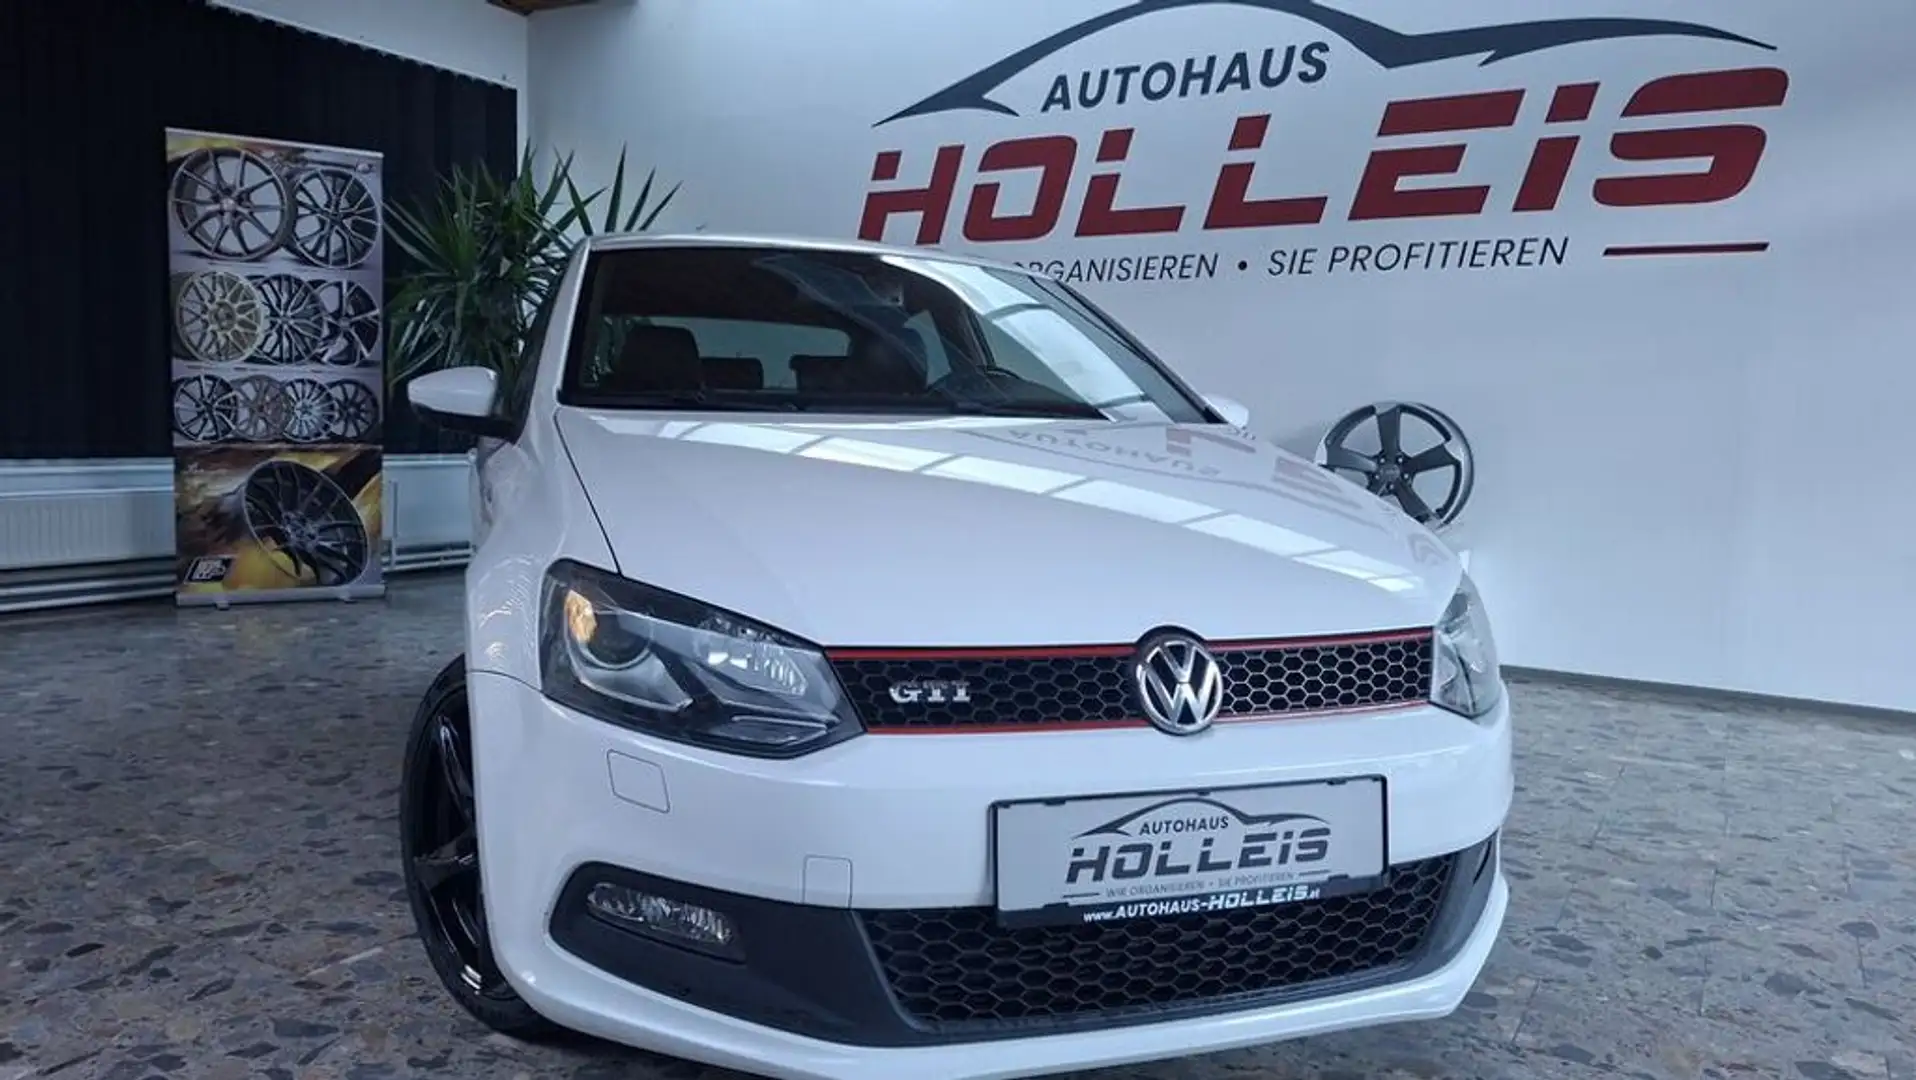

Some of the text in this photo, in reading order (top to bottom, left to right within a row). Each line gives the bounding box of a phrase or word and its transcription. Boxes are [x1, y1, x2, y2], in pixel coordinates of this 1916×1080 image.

[1041, 41, 1330, 113] AUTOHAUS
[858, 67, 1790, 246] HOLLEIS
[1014, 237, 1569, 283] RGANISIEREN SIE PROFITIEREN
[888, 679, 971, 704] GTI
[1139, 816, 1229, 836] AUTOHAUS
[1065, 827, 1331, 884] HOLLEIS
